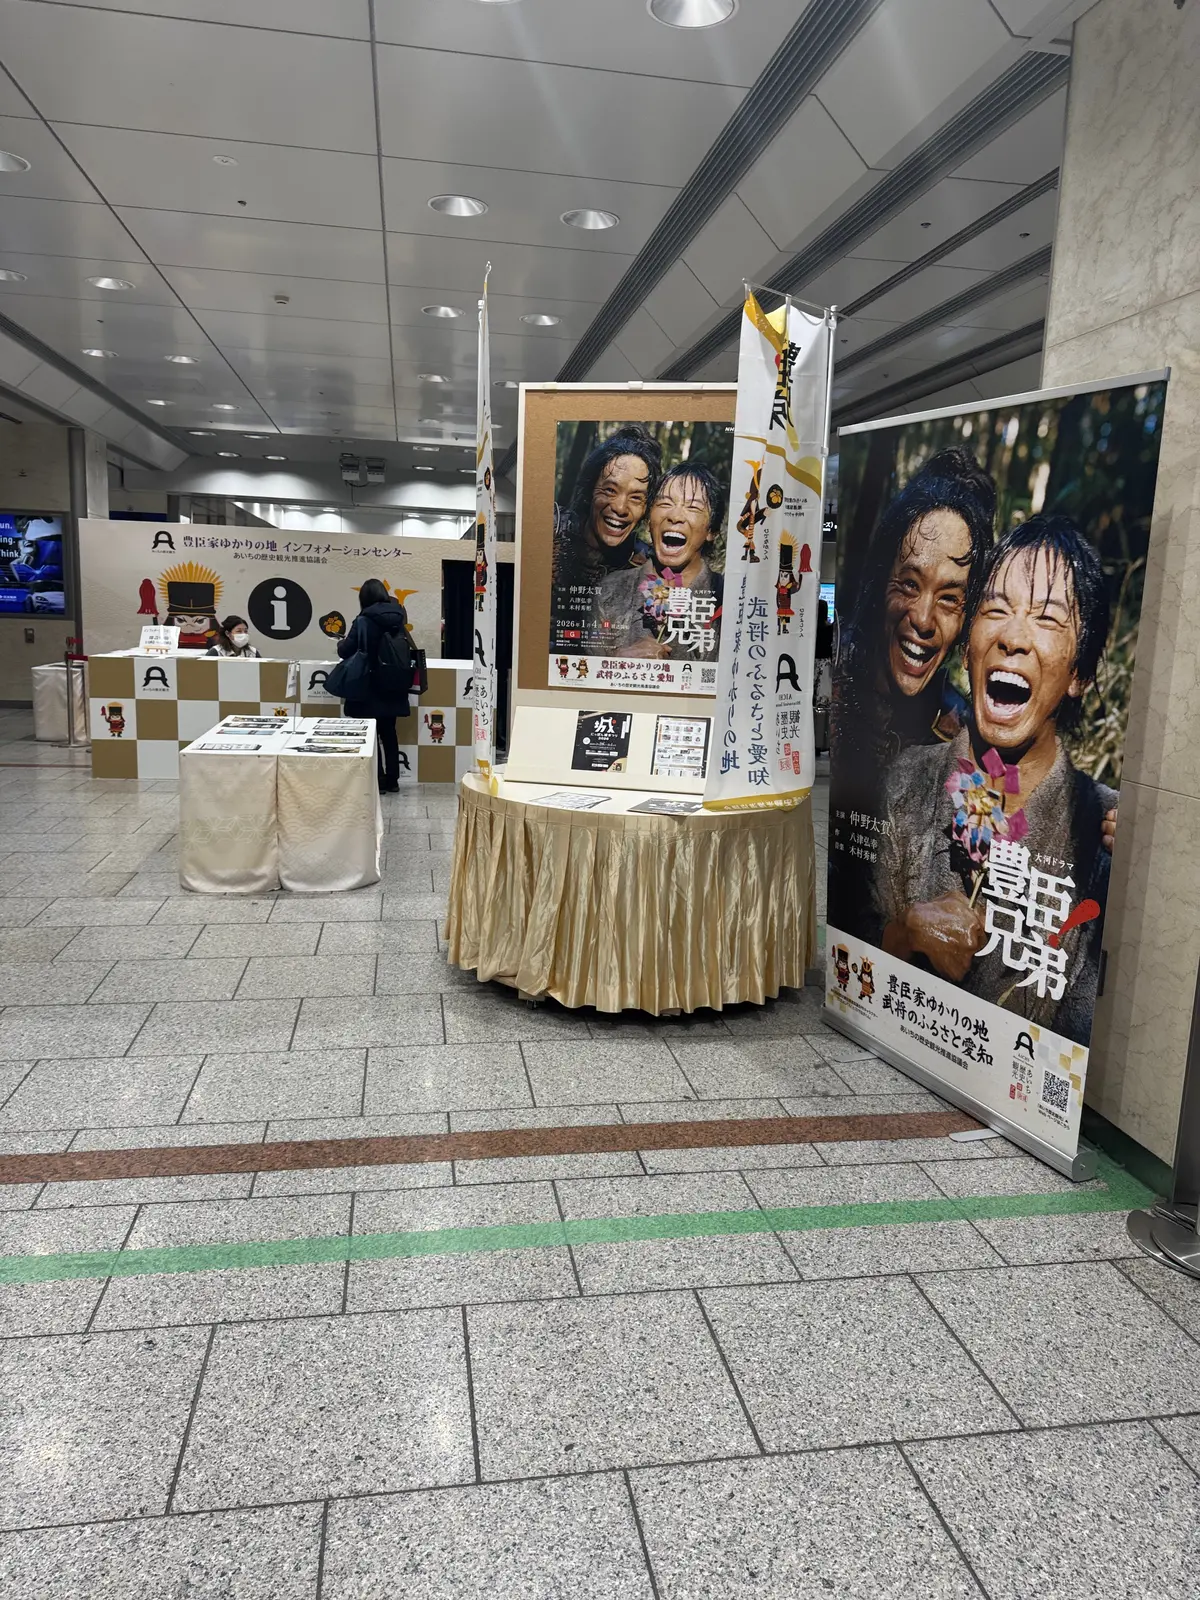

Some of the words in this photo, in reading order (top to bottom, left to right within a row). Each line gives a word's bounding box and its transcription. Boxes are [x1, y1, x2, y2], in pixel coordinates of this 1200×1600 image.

[0, 549, 21, 557] hink.
[183, 536, 277, 552] 豊臣家ゆかりの地
[283, 542, 412, 557] インフォメーションセンター
[233, 552, 328, 564] あいちの歴史観光推進協議会
[601, 660, 671, 673] 豊臣家ゆかりの地
[596, 670, 675, 683] 武将のふるさと愛知
[850, 810, 891, 836] 仲野太賀
[849, 832, 878, 850] 八津弘幸
[849, 845, 878, 863] 木村秀彬
[1034, 852, 1075, 871] 大河ドラマ
[886, 973, 990, 1043] 豊臣家ゆかりの地
[881, 993, 994, 1067] 武将のふるさと愛知
[900, 1024, 969, 1071] あいちの歴史観光推進協議会
